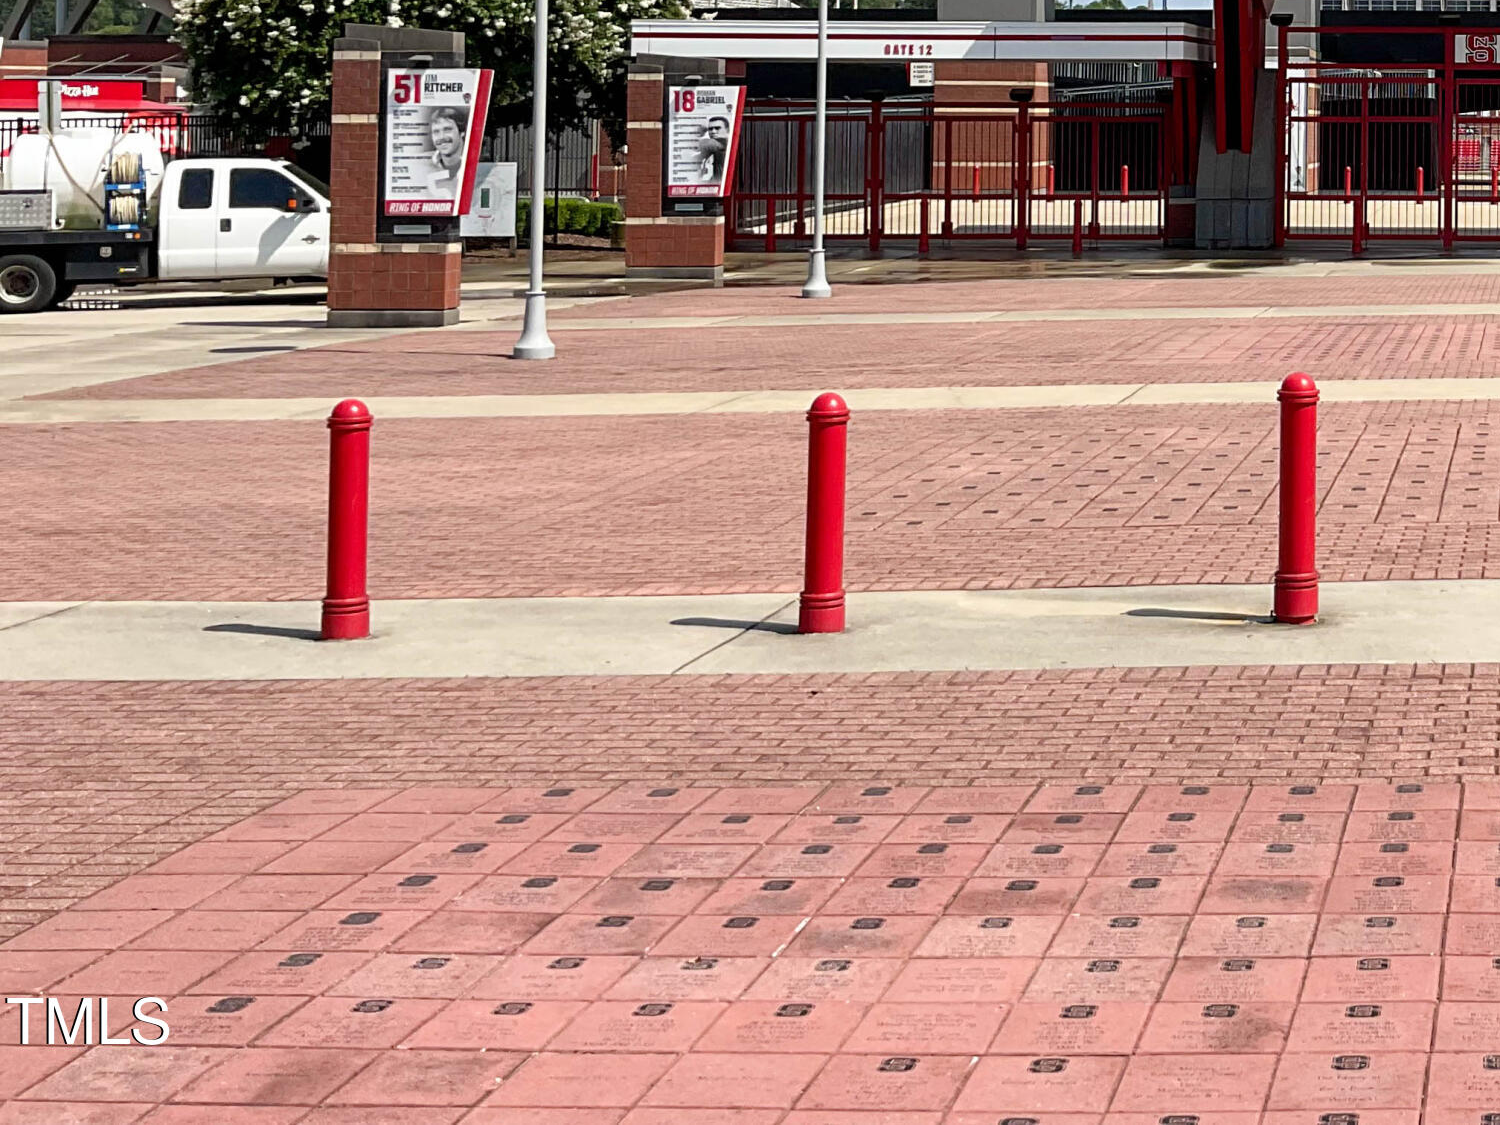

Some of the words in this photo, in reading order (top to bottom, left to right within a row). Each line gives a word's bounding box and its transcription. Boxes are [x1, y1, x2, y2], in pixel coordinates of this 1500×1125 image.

[884, 43, 914, 56] GATE
[919, 44, 933, 56] 12
[394, 74, 422, 104] 51
[424, 82, 464, 93] RITCHER
[673, 90, 695, 113] 18
[389, 202, 410, 213] RING
[410, 202, 422, 213] OF
[422, 202, 452, 213] HONOR
